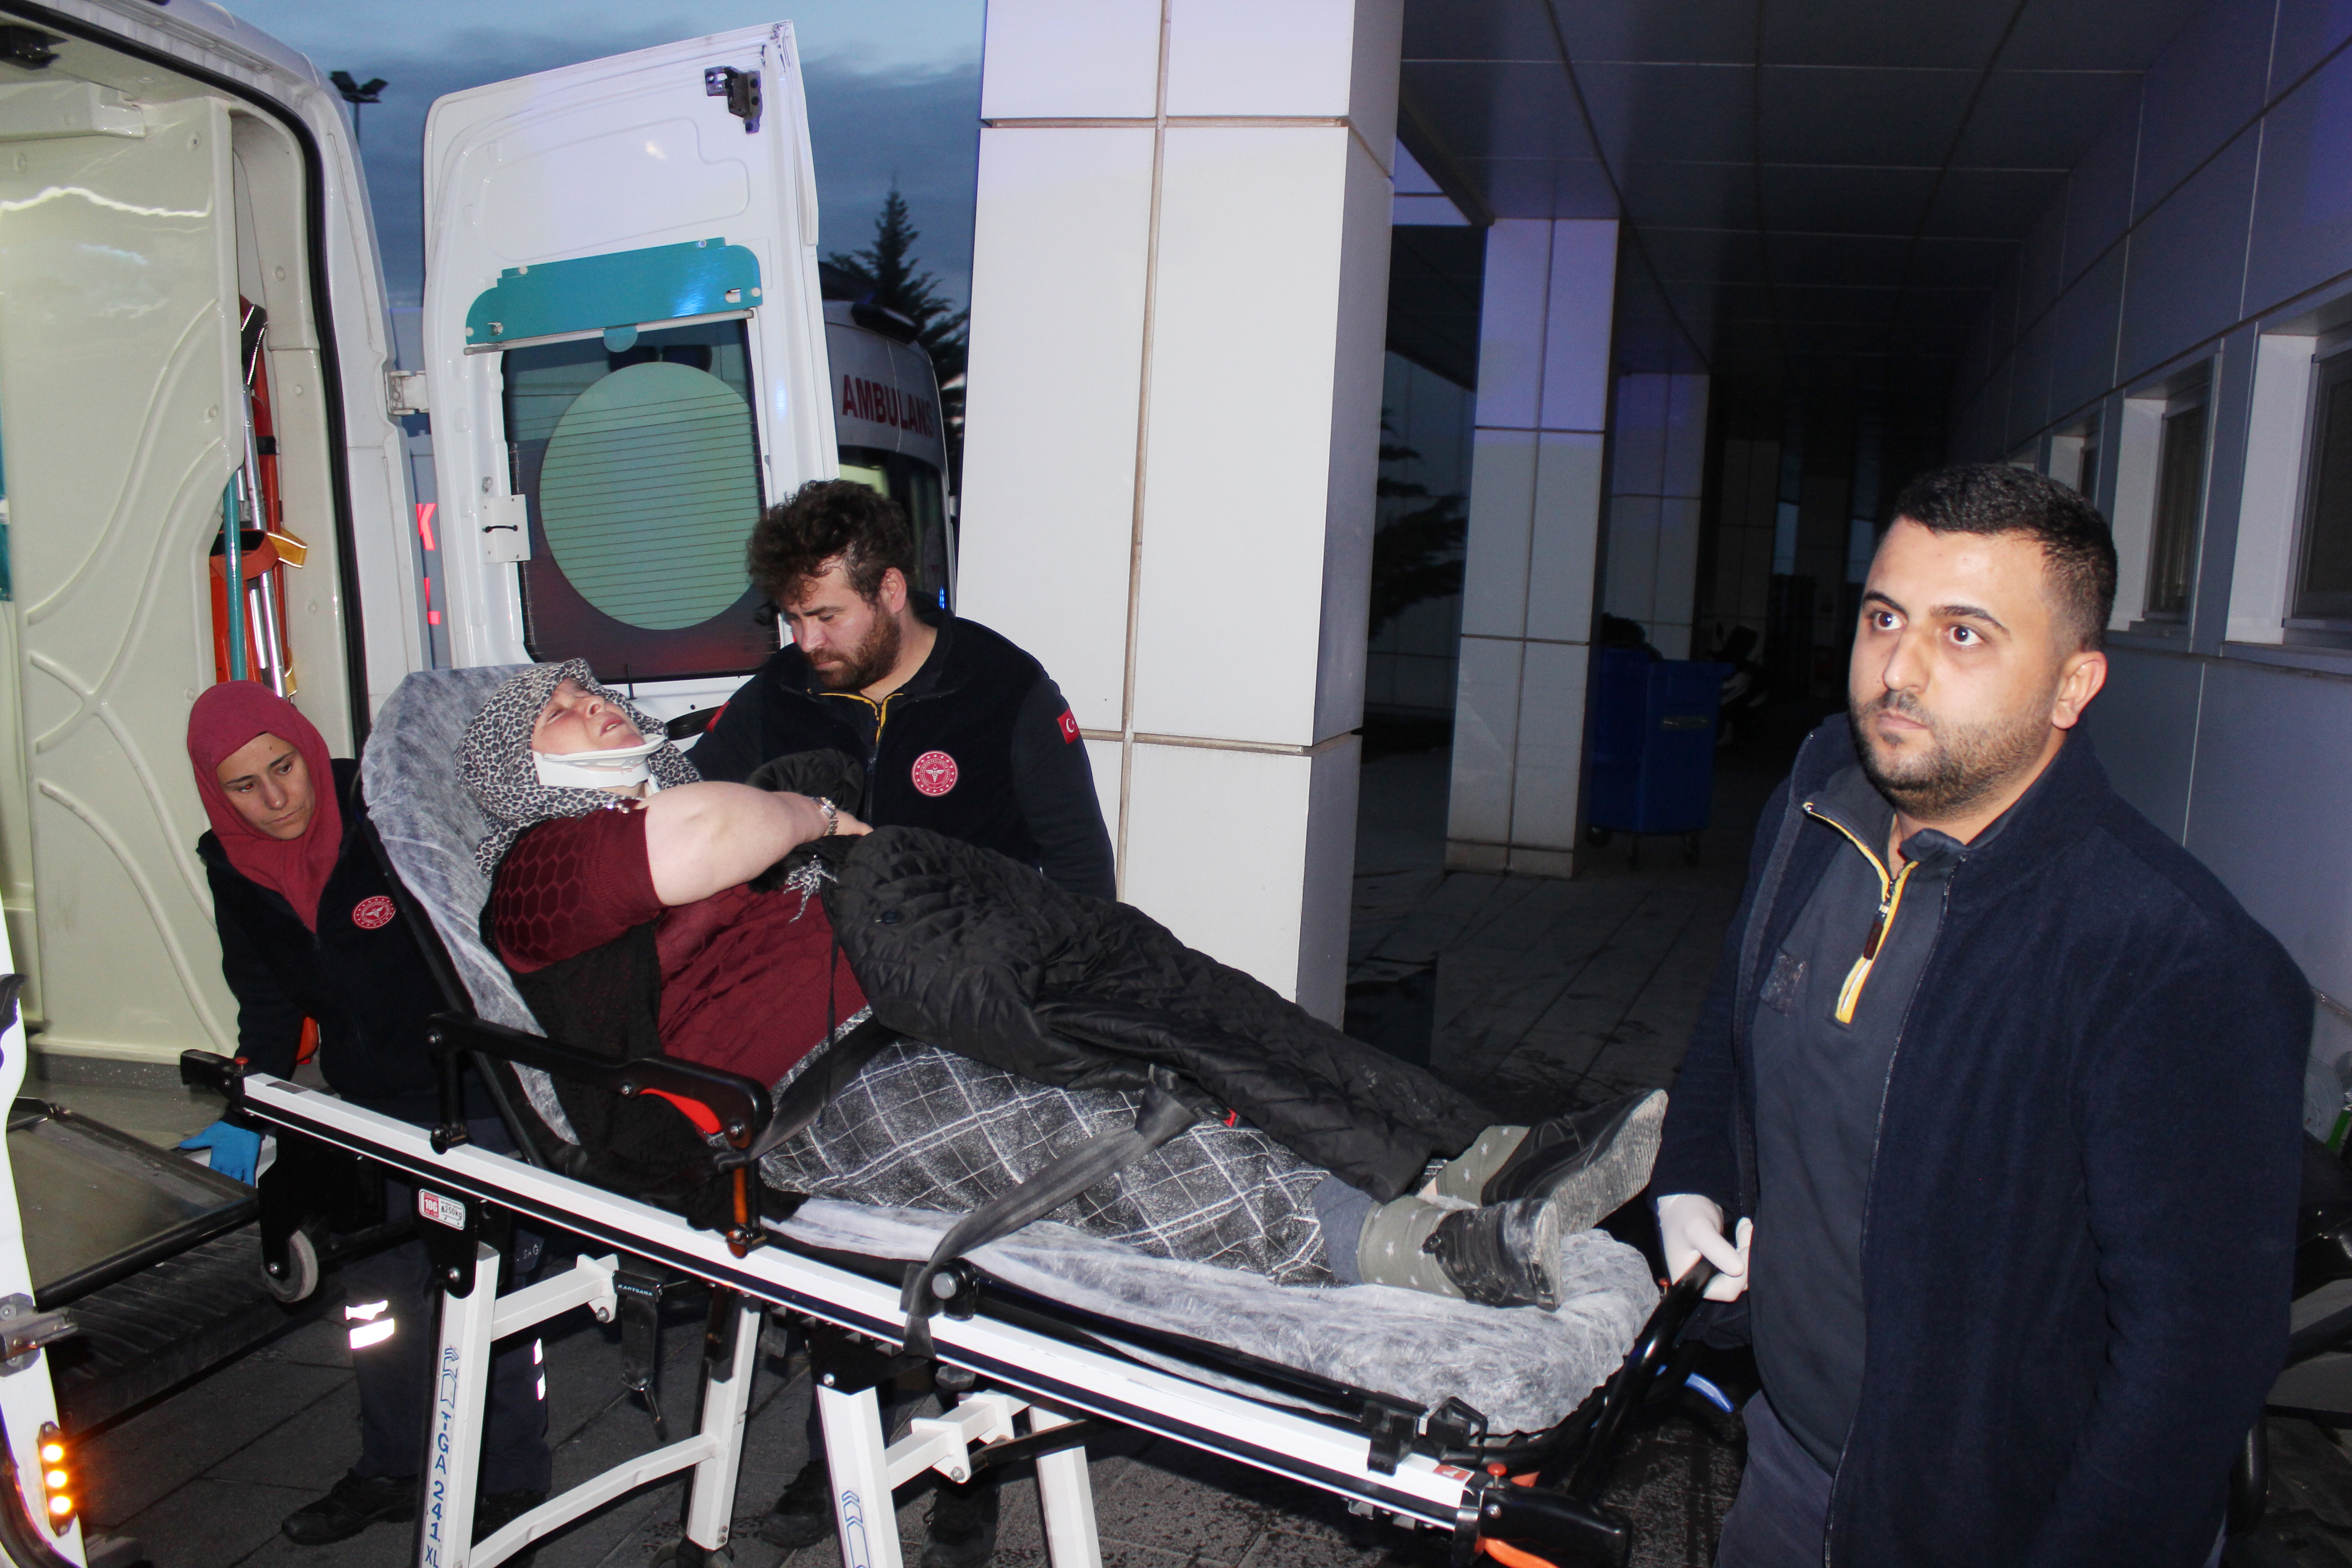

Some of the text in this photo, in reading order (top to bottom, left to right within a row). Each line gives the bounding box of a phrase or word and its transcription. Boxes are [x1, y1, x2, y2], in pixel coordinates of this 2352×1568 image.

[843, 374, 934, 439] AMBULANS
[425, 1199, 438, 1213] 10G
[618, 1284, 653, 1296] KARTSANA
